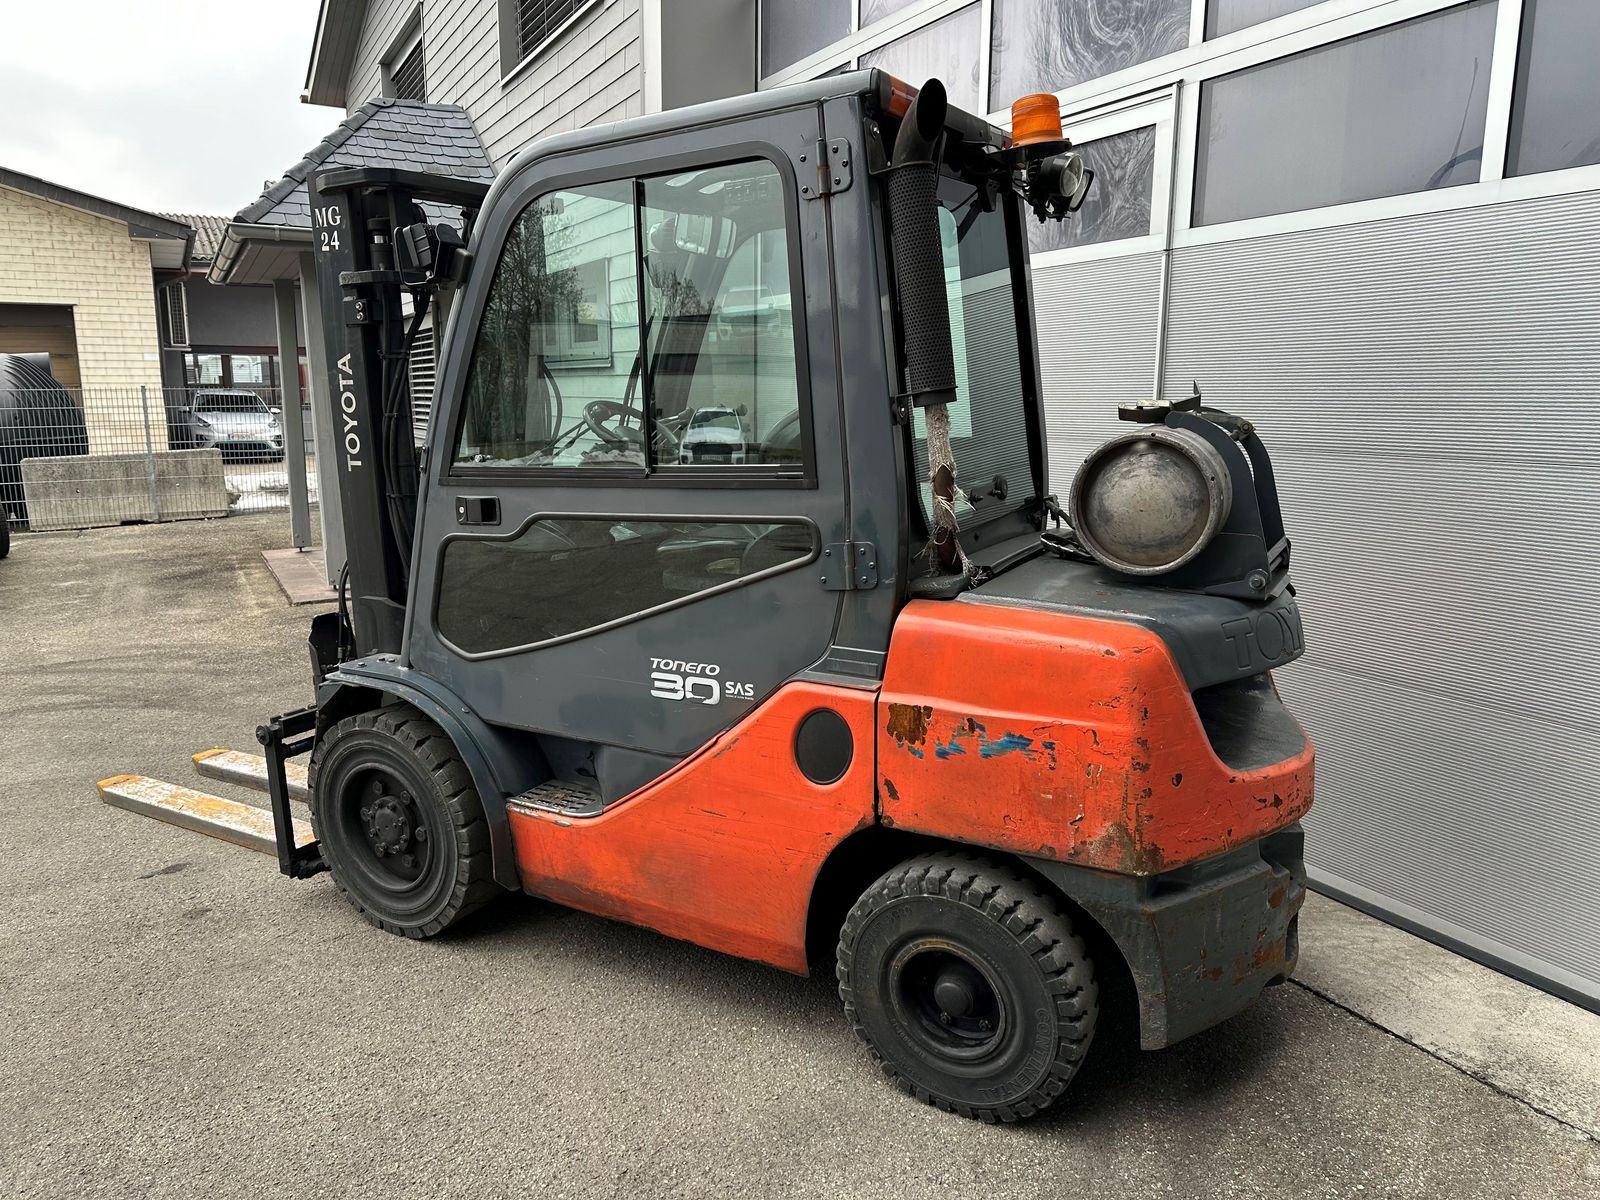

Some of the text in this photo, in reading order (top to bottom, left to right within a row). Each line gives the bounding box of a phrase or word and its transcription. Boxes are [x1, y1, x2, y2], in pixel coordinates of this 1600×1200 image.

[314, 205, 342, 228] MG
[321, 230, 340, 252] 24
[337, 352, 362, 472] TOYOTA
[650, 671, 754, 705] 30 SAS
